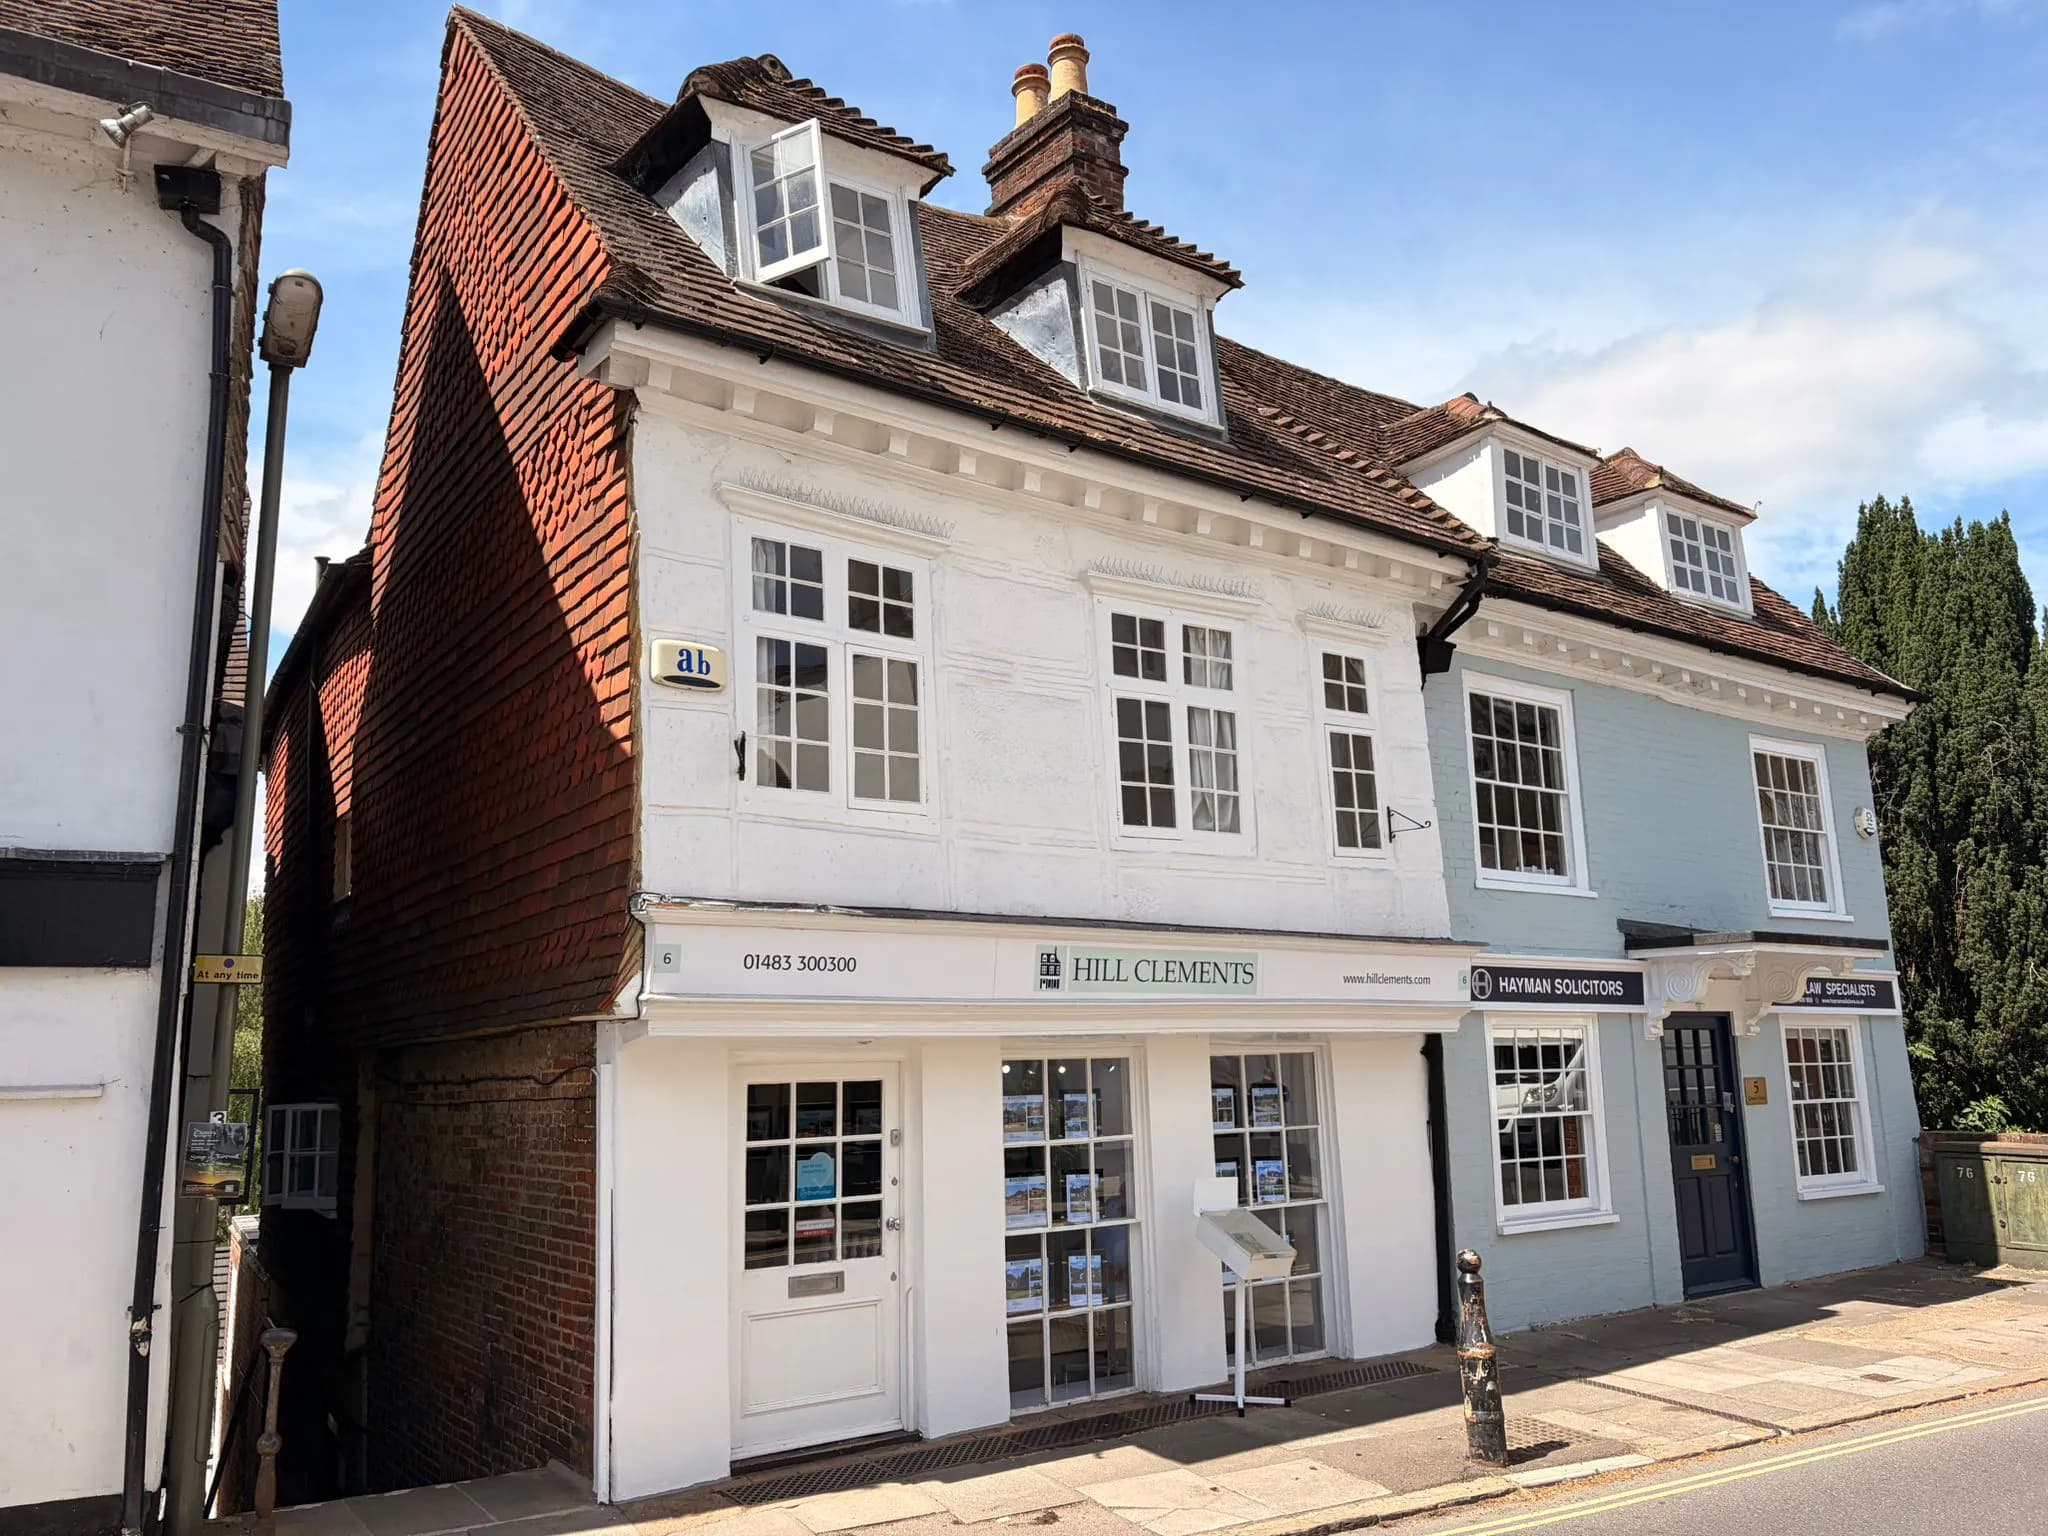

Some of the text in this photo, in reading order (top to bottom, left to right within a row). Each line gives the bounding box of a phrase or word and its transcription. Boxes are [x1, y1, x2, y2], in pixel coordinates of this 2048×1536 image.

[677, 648, 711, 676] ab
[663, 953, 672, 964] 6
[743, 954, 857, 972] 01483 300300
[196, 971, 259, 981] At any time
[1072, 957, 1254, 985] HILL CLEMENTS
[1343, 973, 1431, 985] www.hillclements.com
[1462, 975, 1468, 985] 6
[1499, 976, 1624, 996] HAYMAN SOLICITORS
[1826, 982, 1876, 996] SPECIALISTS
[1753, 1080, 1760, 1094] 5
[1957, 1167, 1974, 1179] 76
[2018, 1170, 2036, 1182] 76
